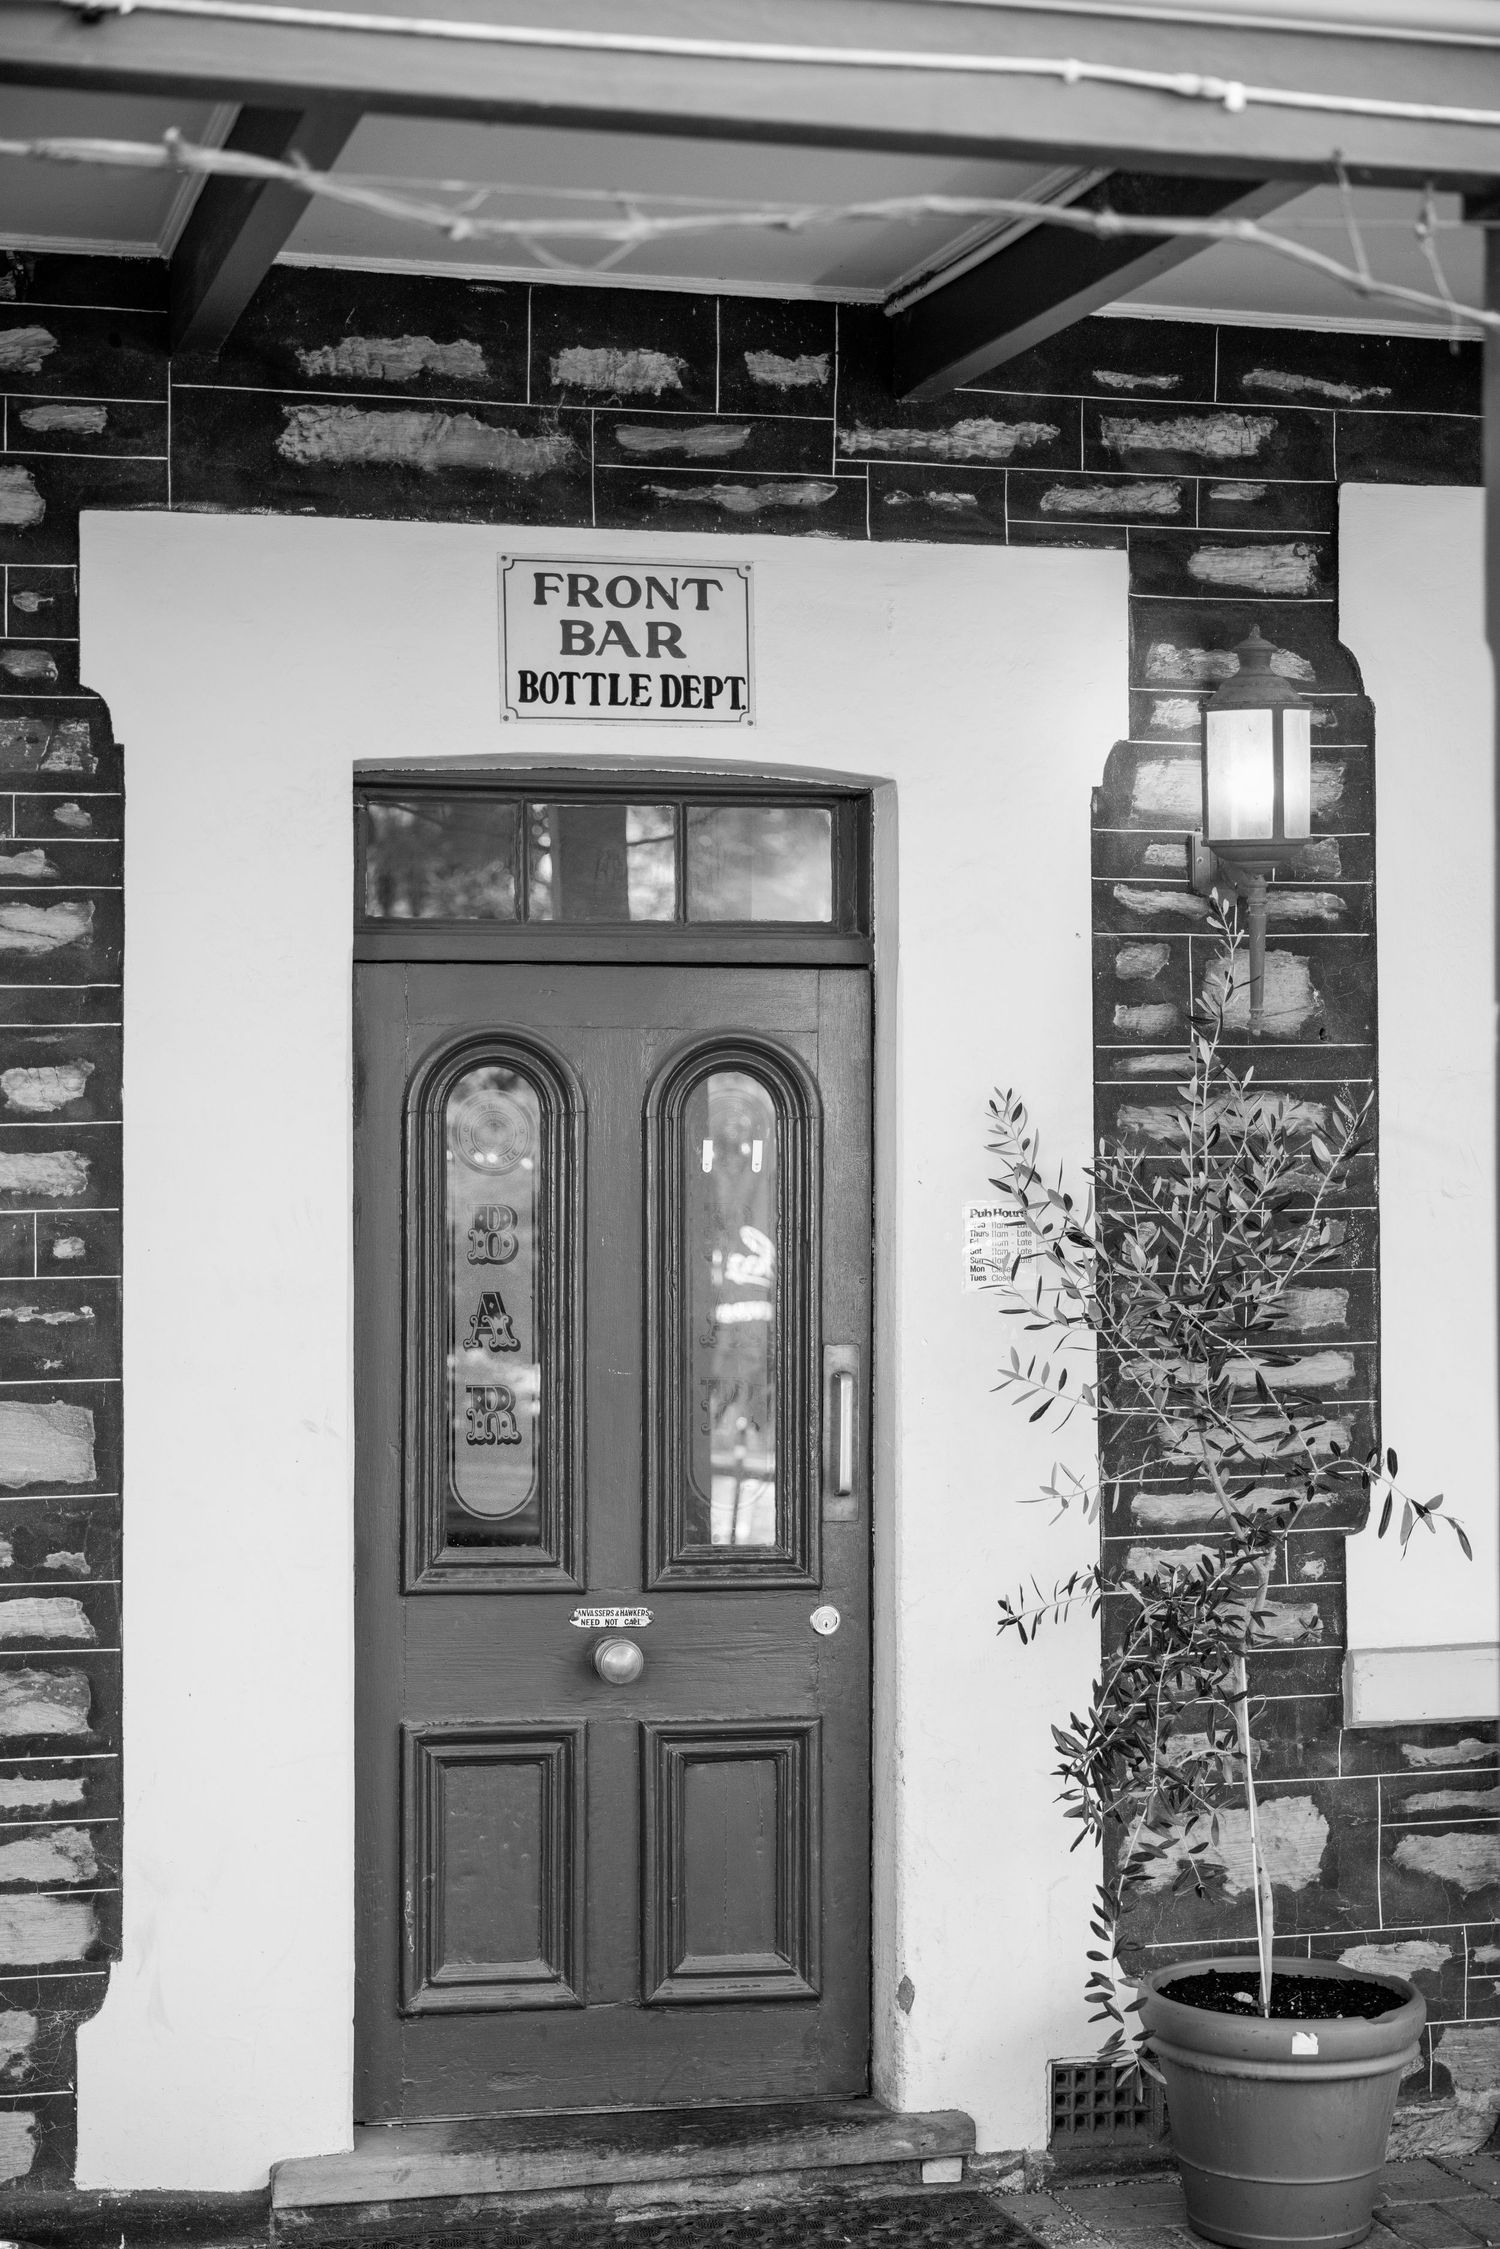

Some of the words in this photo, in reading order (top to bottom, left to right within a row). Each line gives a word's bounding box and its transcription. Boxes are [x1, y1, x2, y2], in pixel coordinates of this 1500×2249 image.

[533, 572, 723, 611] FRONT
[559, 619, 687, 659] BAR
[517, 670, 652, 707] BOTTLE
[660, 674, 747, 710] DEPT.
[969, 1208, 992, 1218] Pub
[1016, 1229, 1032, 1238] Late
[1016, 1238, 1032, 1246] Late
[1016, 1247, 1032, 1255] Late
[969, 1265, 985, 1273] Mon
[969, 1273, 987, 1281] Tues
[991, 1274, 1014, 1282] Close
[575, 1609, 615, 1617] ANVASSERS
[580, 1618, 600, 1626] NEED
[604, 1618, 618, 1626] NOT
